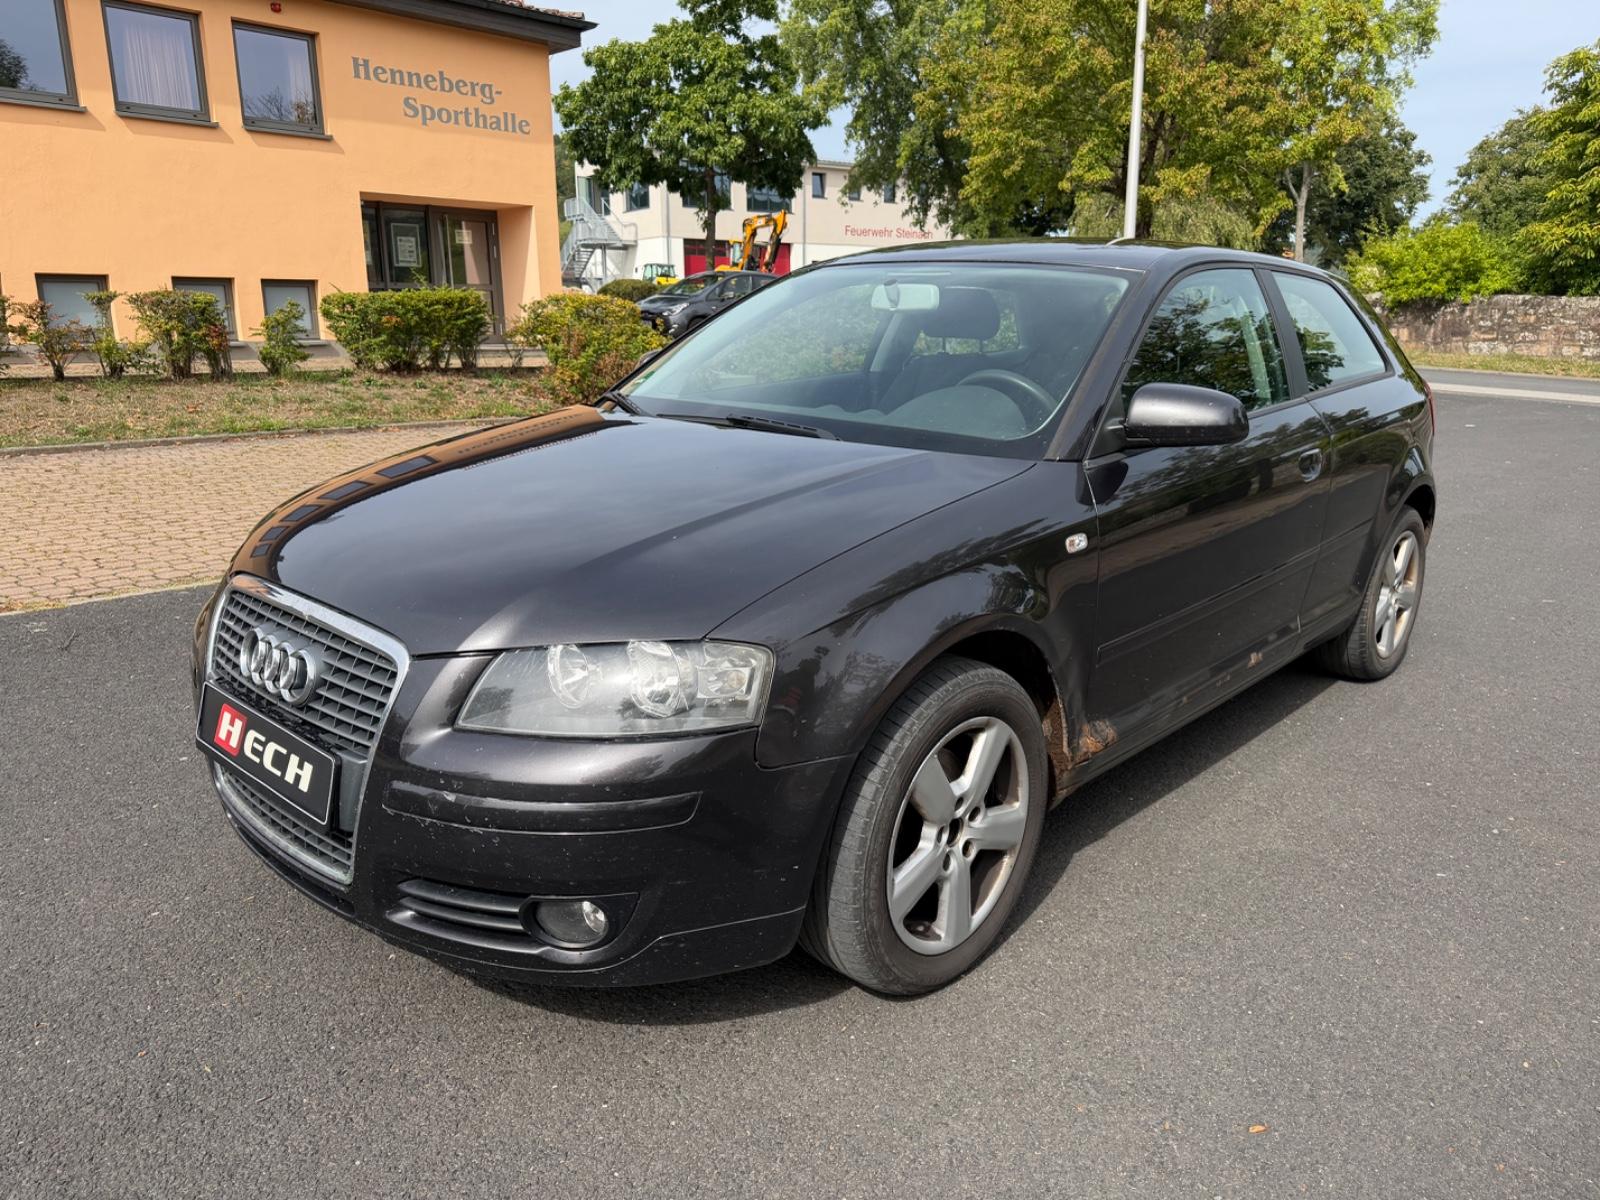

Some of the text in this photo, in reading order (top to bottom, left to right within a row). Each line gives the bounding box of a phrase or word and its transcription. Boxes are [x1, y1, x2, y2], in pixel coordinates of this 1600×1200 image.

[351, 56, 503, 105] Henneberg-
[403, 96, 531, 135] Sporthalle
[844, 225, 893, 238] Feuerwehr
[217, 710, 314, 793] HECH
